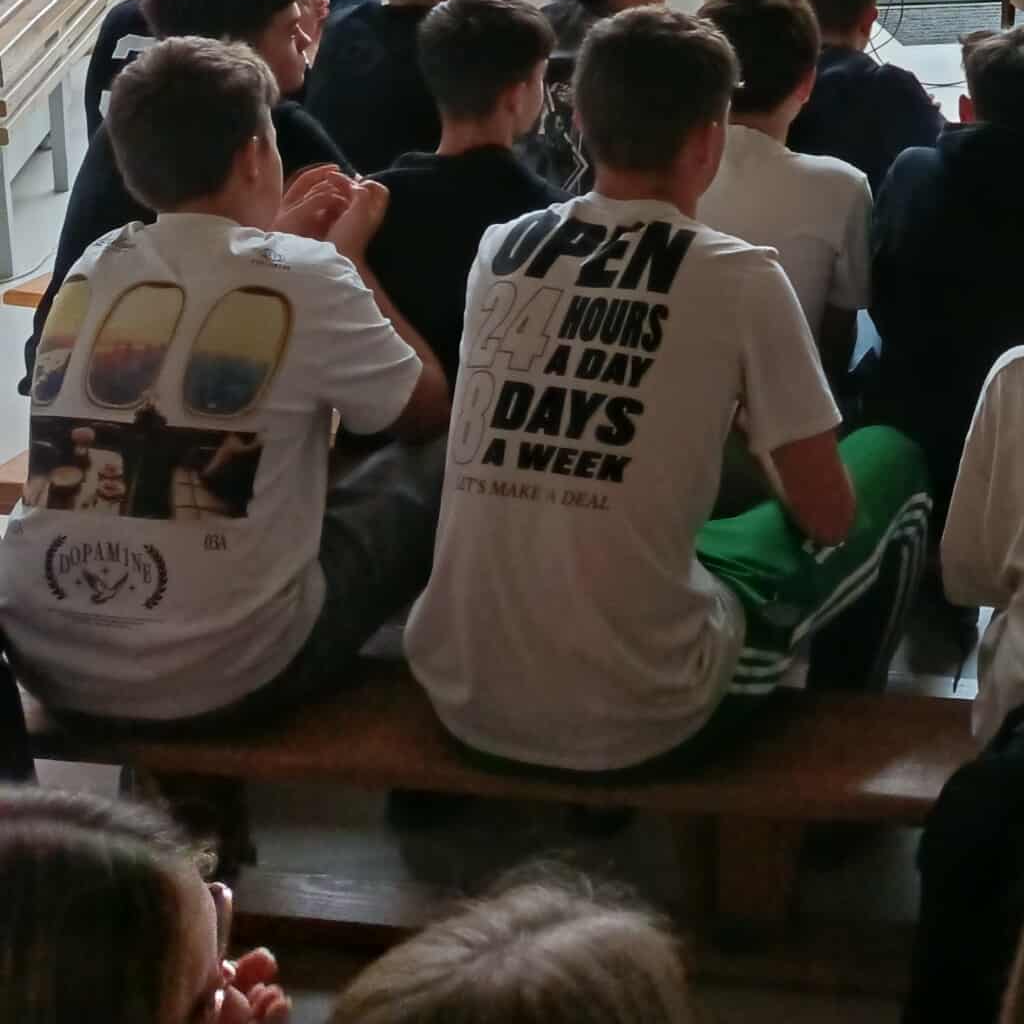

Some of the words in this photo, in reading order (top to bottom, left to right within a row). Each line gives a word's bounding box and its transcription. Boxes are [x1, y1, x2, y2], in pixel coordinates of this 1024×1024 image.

[492, 209, 697, 295] OPEN
[467, 280, 565, 372] 24
[557, 295, 670, 353] HOURS
[544, 344, 572, 376] A
[572, 348, 655, 388] DAY
[490, 380, 645, 447] DAYS
[482, 438, 507, 467] A
[517, 441, 633, 484] WEEK
[487, 480, 539, 502] MAKE
[561, 488, 611, 511] DEAL
